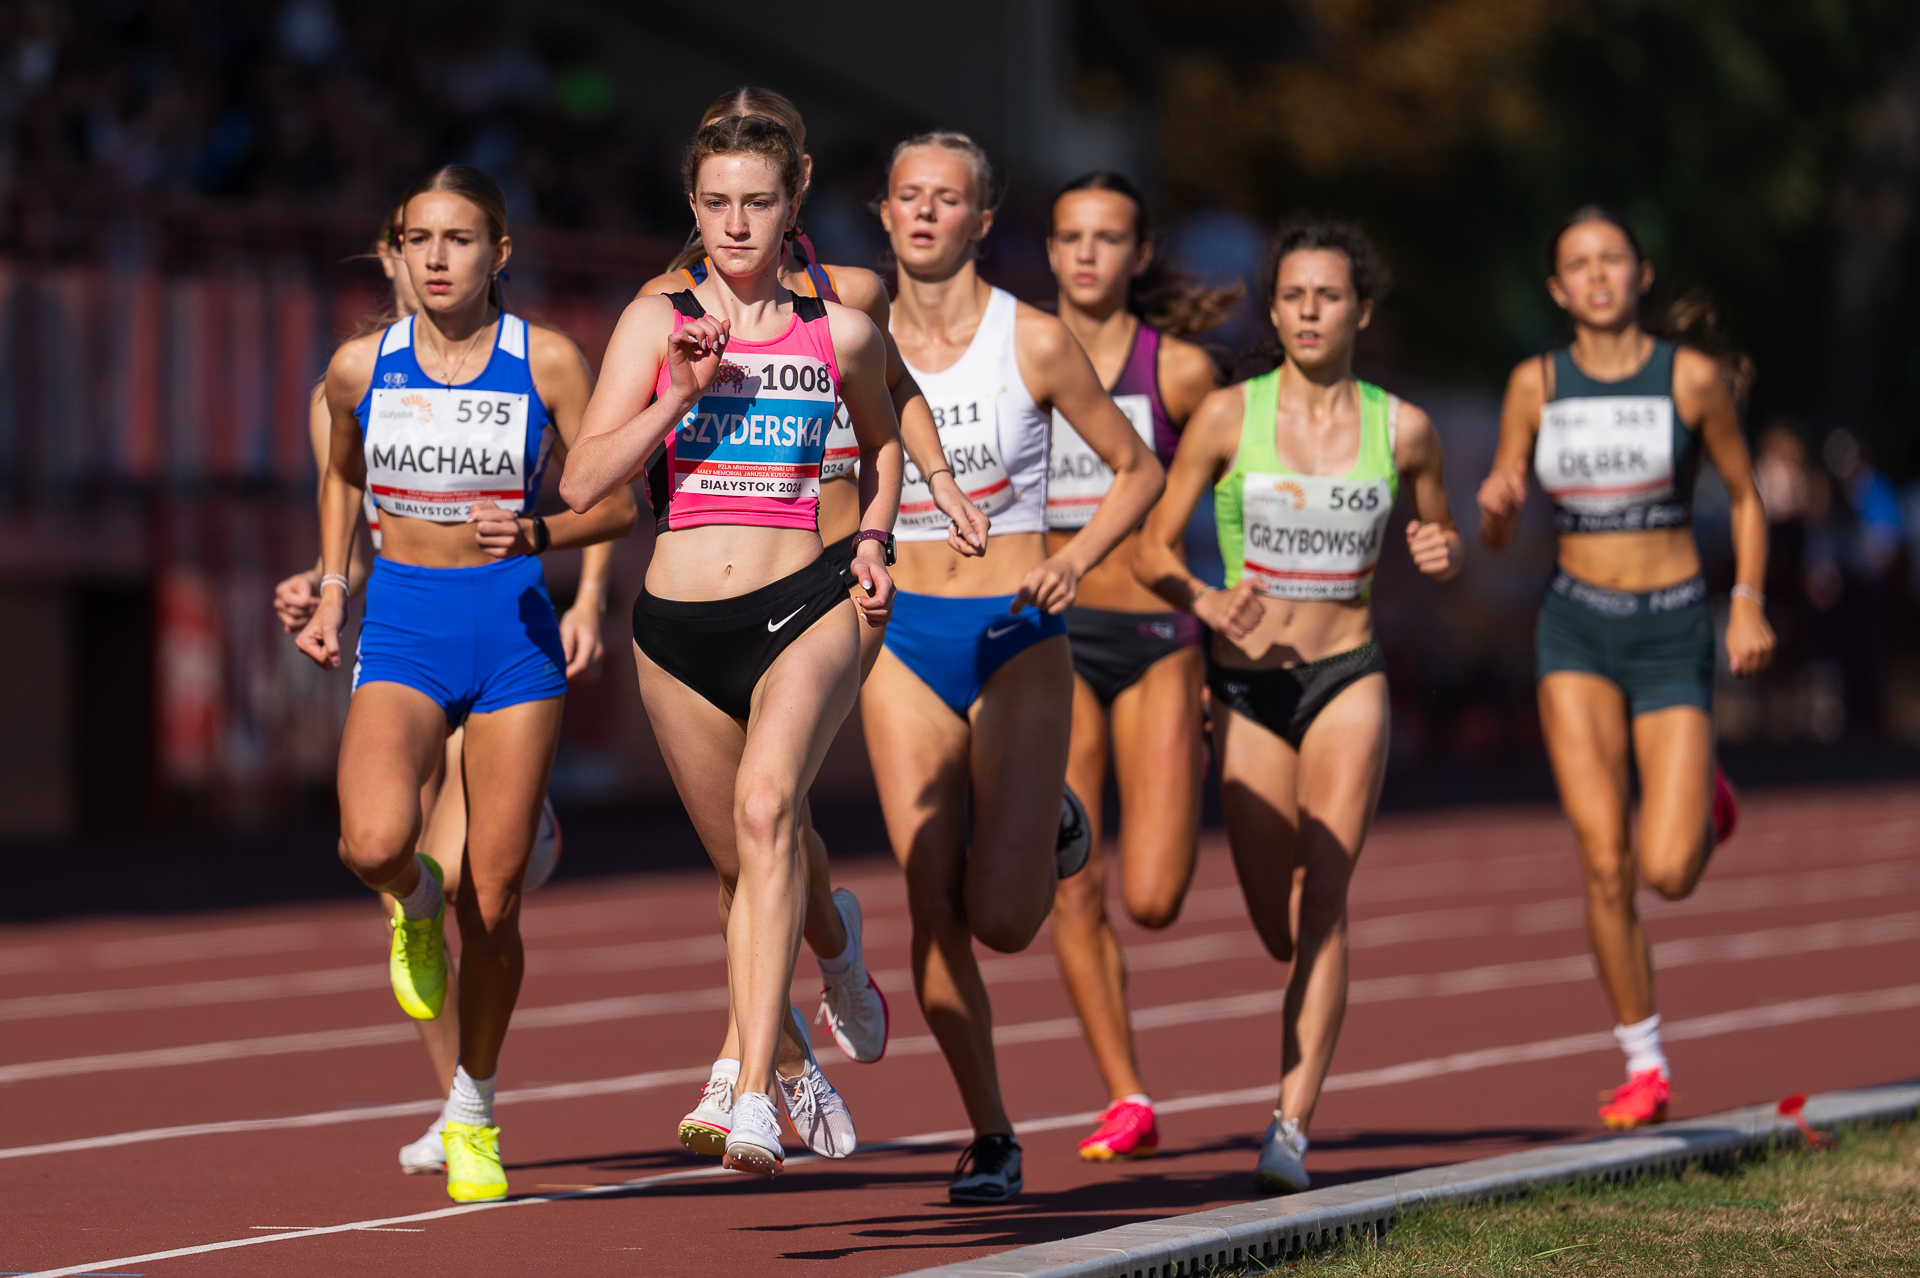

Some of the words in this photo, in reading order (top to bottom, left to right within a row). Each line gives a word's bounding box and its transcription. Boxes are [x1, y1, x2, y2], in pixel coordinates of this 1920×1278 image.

[761, 364, 830, 393] 1008
[456, 399, 511, 426] 595
[682, 411, 823, 447] SZYDERSKA
[372, 443, 517, 476] MACHAŁA
[823, 462, 844, 474] 024
[700, 479, 775, 492] BIAŁYSTOK
[778, 482, 802, 493] 2024
[1329, 486, 1379, 512] 565
[394, 501, 461, 517] BIAŁYSTOK
